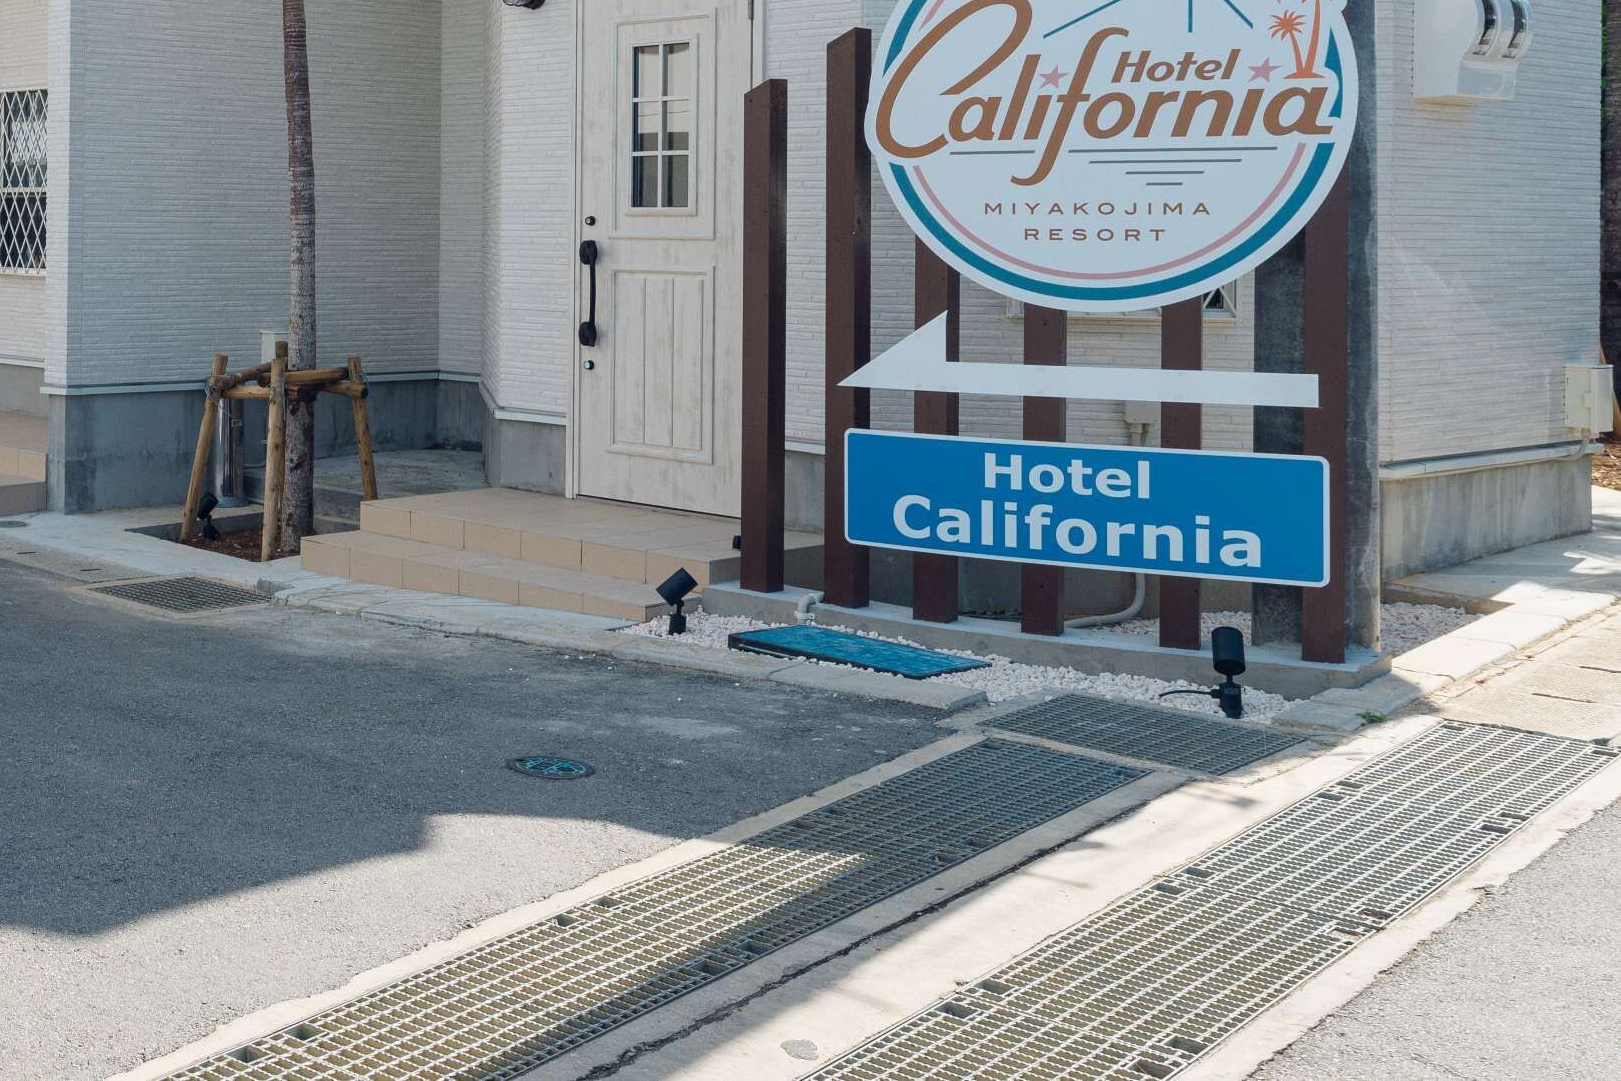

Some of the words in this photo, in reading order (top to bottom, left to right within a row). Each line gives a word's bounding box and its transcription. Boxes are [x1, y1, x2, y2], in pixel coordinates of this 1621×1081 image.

[1110, 48, 1241, 83] Hotel
[984, 202, 1211, 216] MIYAKOJIMA
[1024, 228, 1167, 242] RESORT
[984, 452, 1150, 499] Hotel
[892, 494, 1262, 568] California
